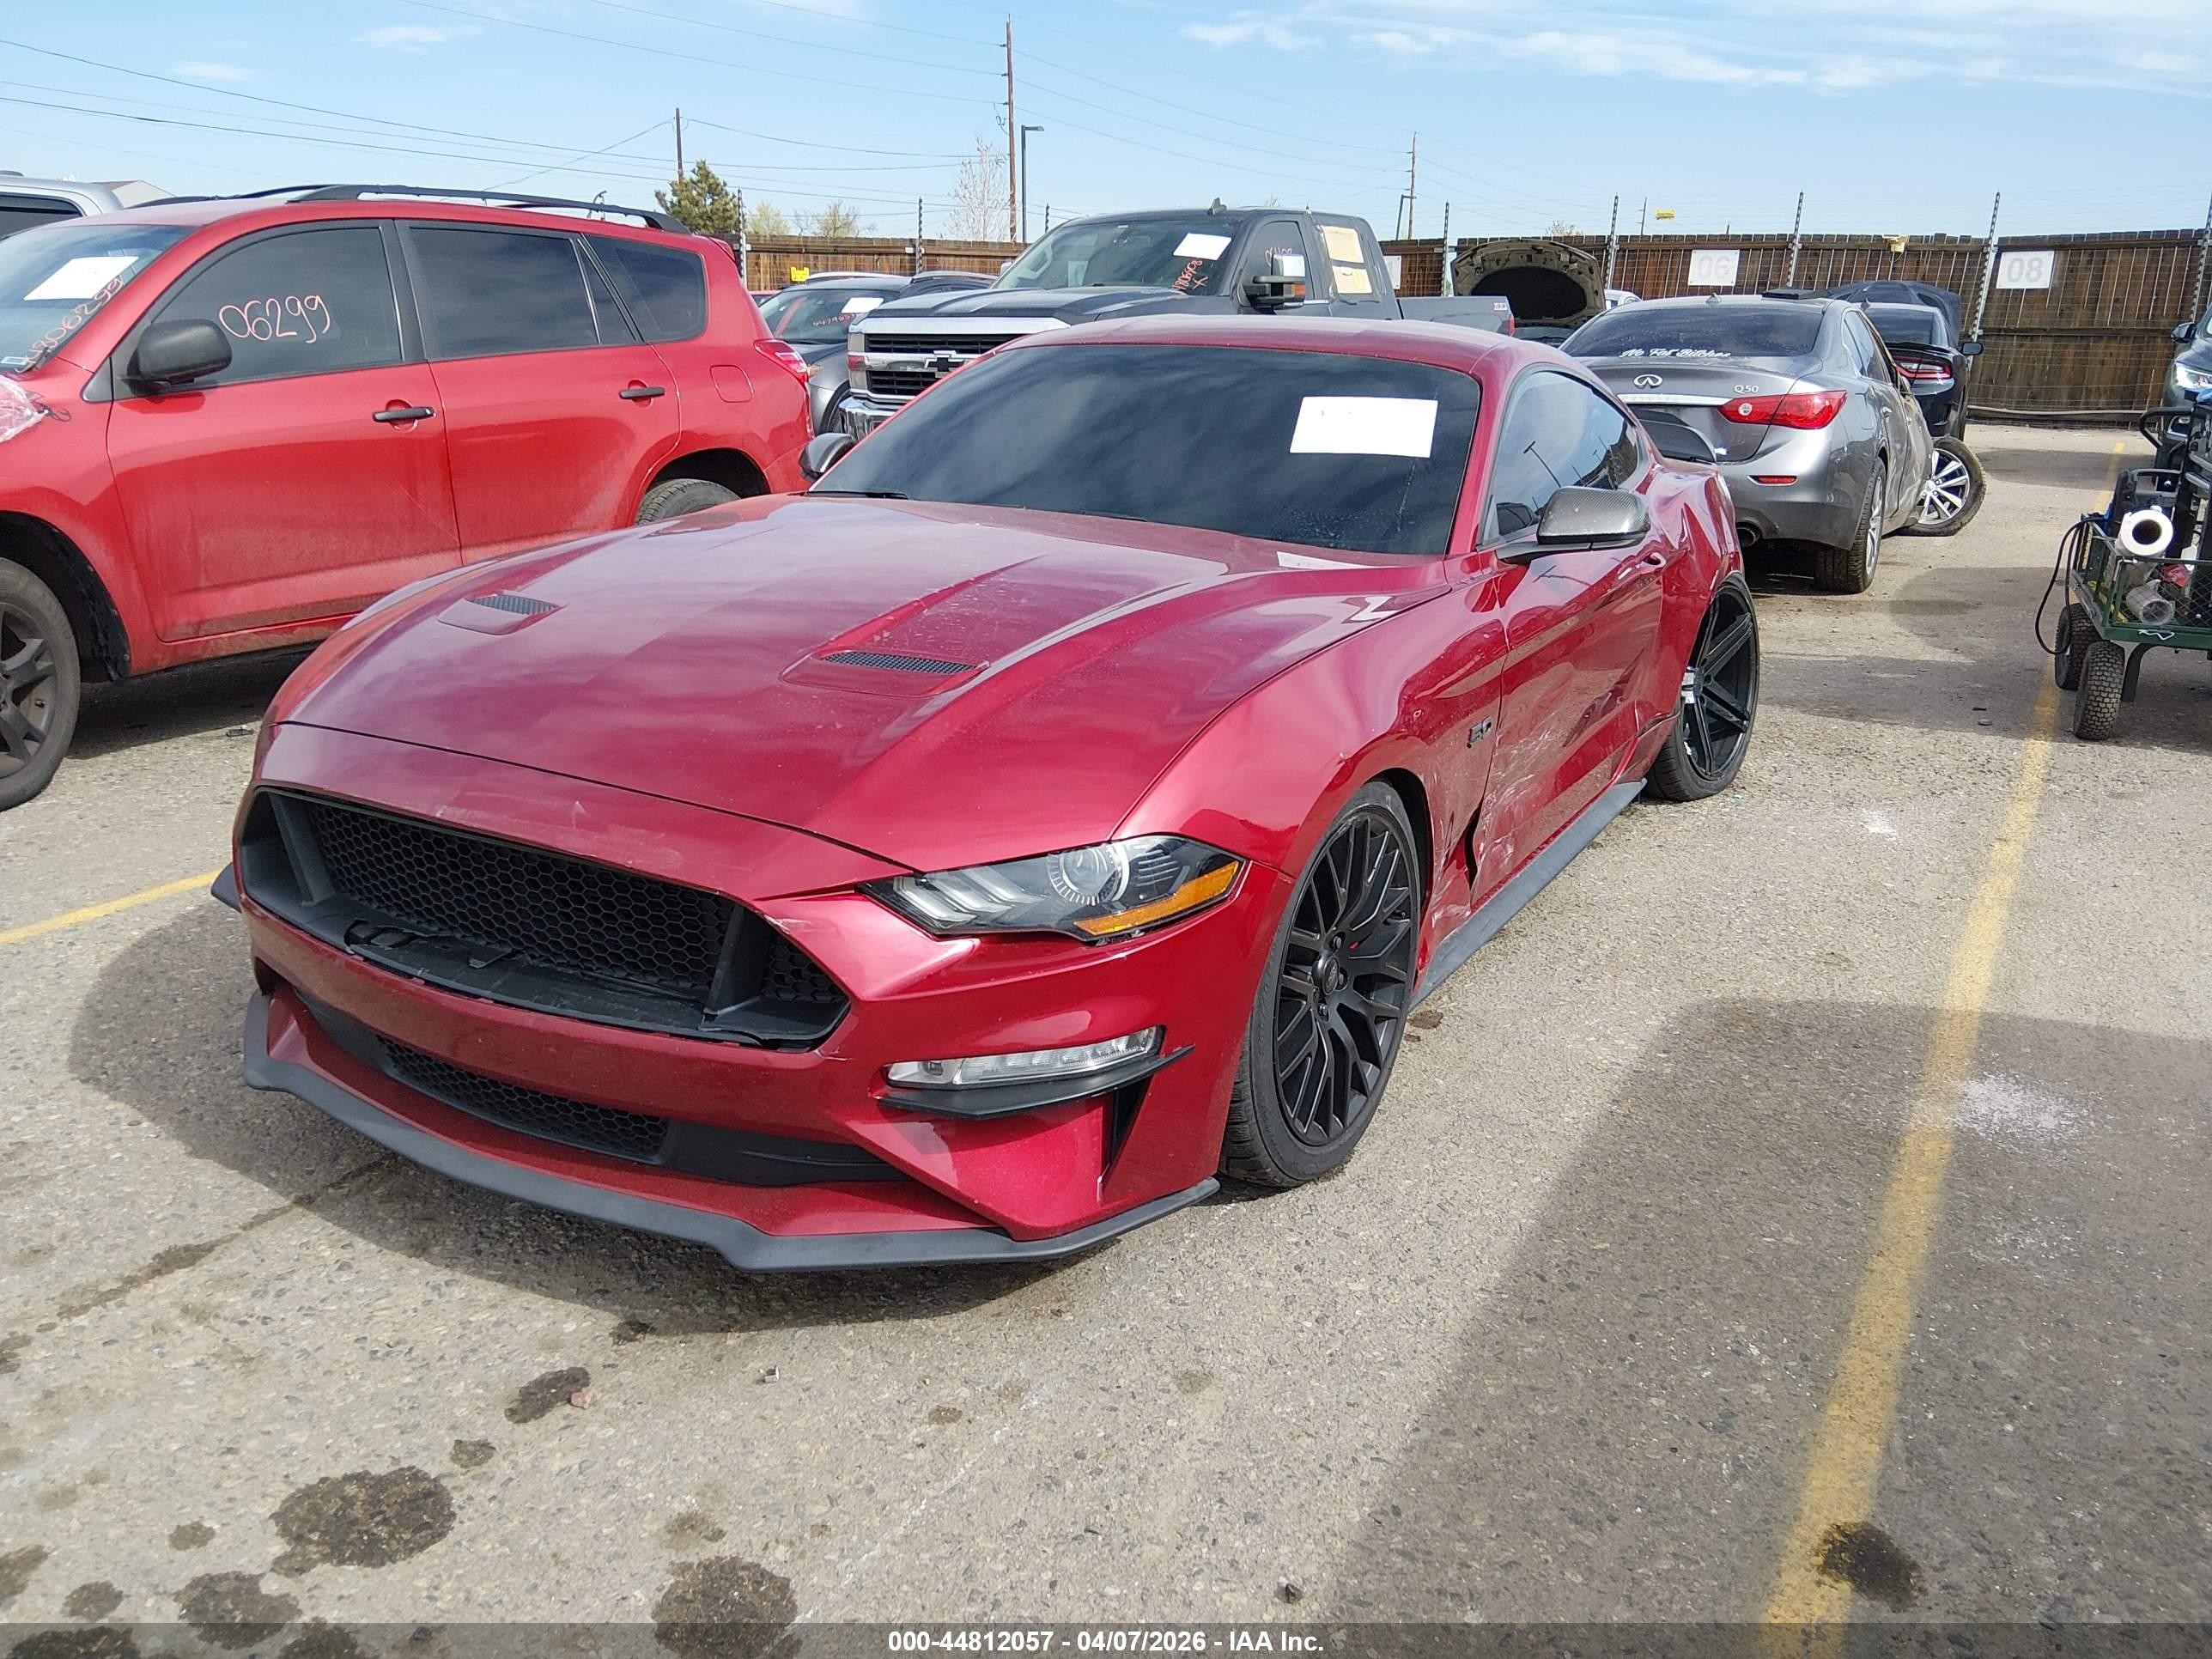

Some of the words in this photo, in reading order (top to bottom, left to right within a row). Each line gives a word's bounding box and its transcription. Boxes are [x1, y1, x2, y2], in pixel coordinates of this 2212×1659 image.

[1697, 255, 1732, 278] 06
[2007, 257, 2044, 283] 08
[218, 295, 331, 343] 06299
[1619, 348, 1645, 358] No
[1649, 348, 1679, 357] Fat
[1733, 385, 1759, 394] Q50
